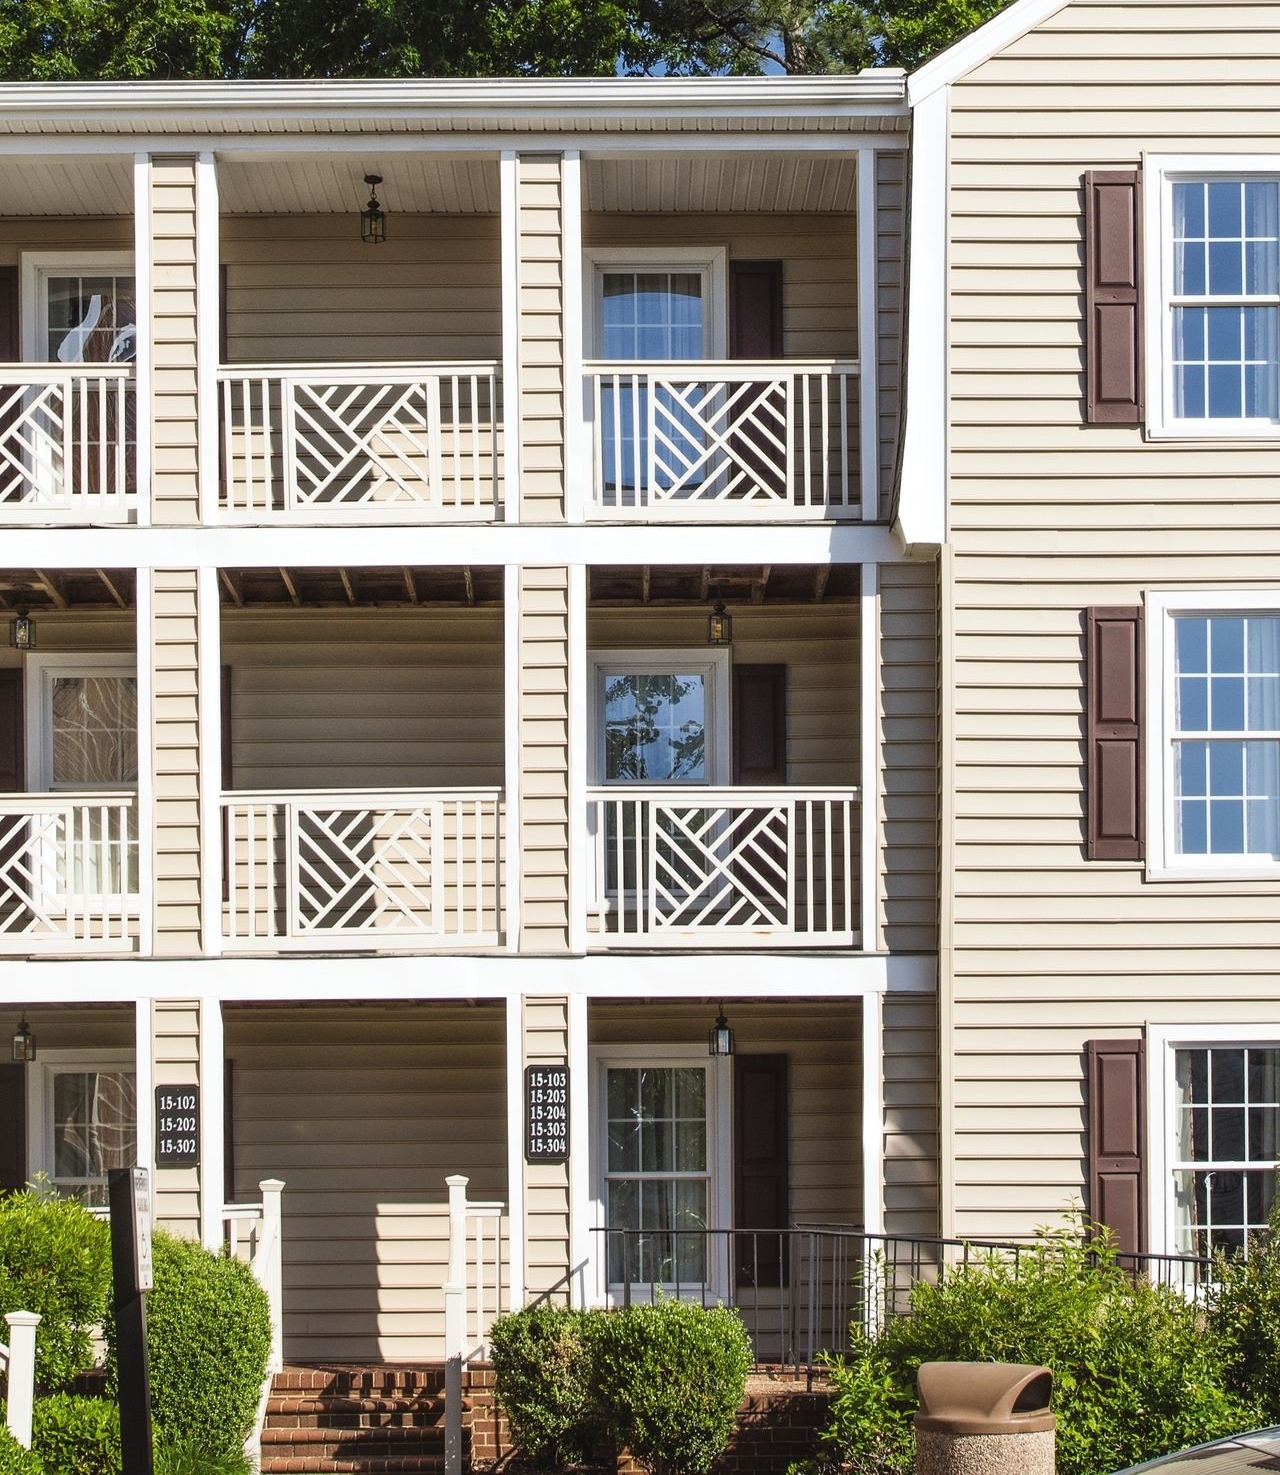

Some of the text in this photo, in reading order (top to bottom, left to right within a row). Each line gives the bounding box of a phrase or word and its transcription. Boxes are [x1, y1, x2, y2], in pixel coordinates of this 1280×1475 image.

[530, 1072, 566, 1087] 15-103
[160, 1095, 196, 1110] 15-102
[530, 1089, 566, 1104] 15-203
[530, 1105, 566, 1120] 15-204
[160, 1117, 196, 1132] 15-202
[530, 1122, 566, 1136] 15-303
[160, 1139, 196, 1153] 15-302
[530, 1137, 566, 1153] 15-304
